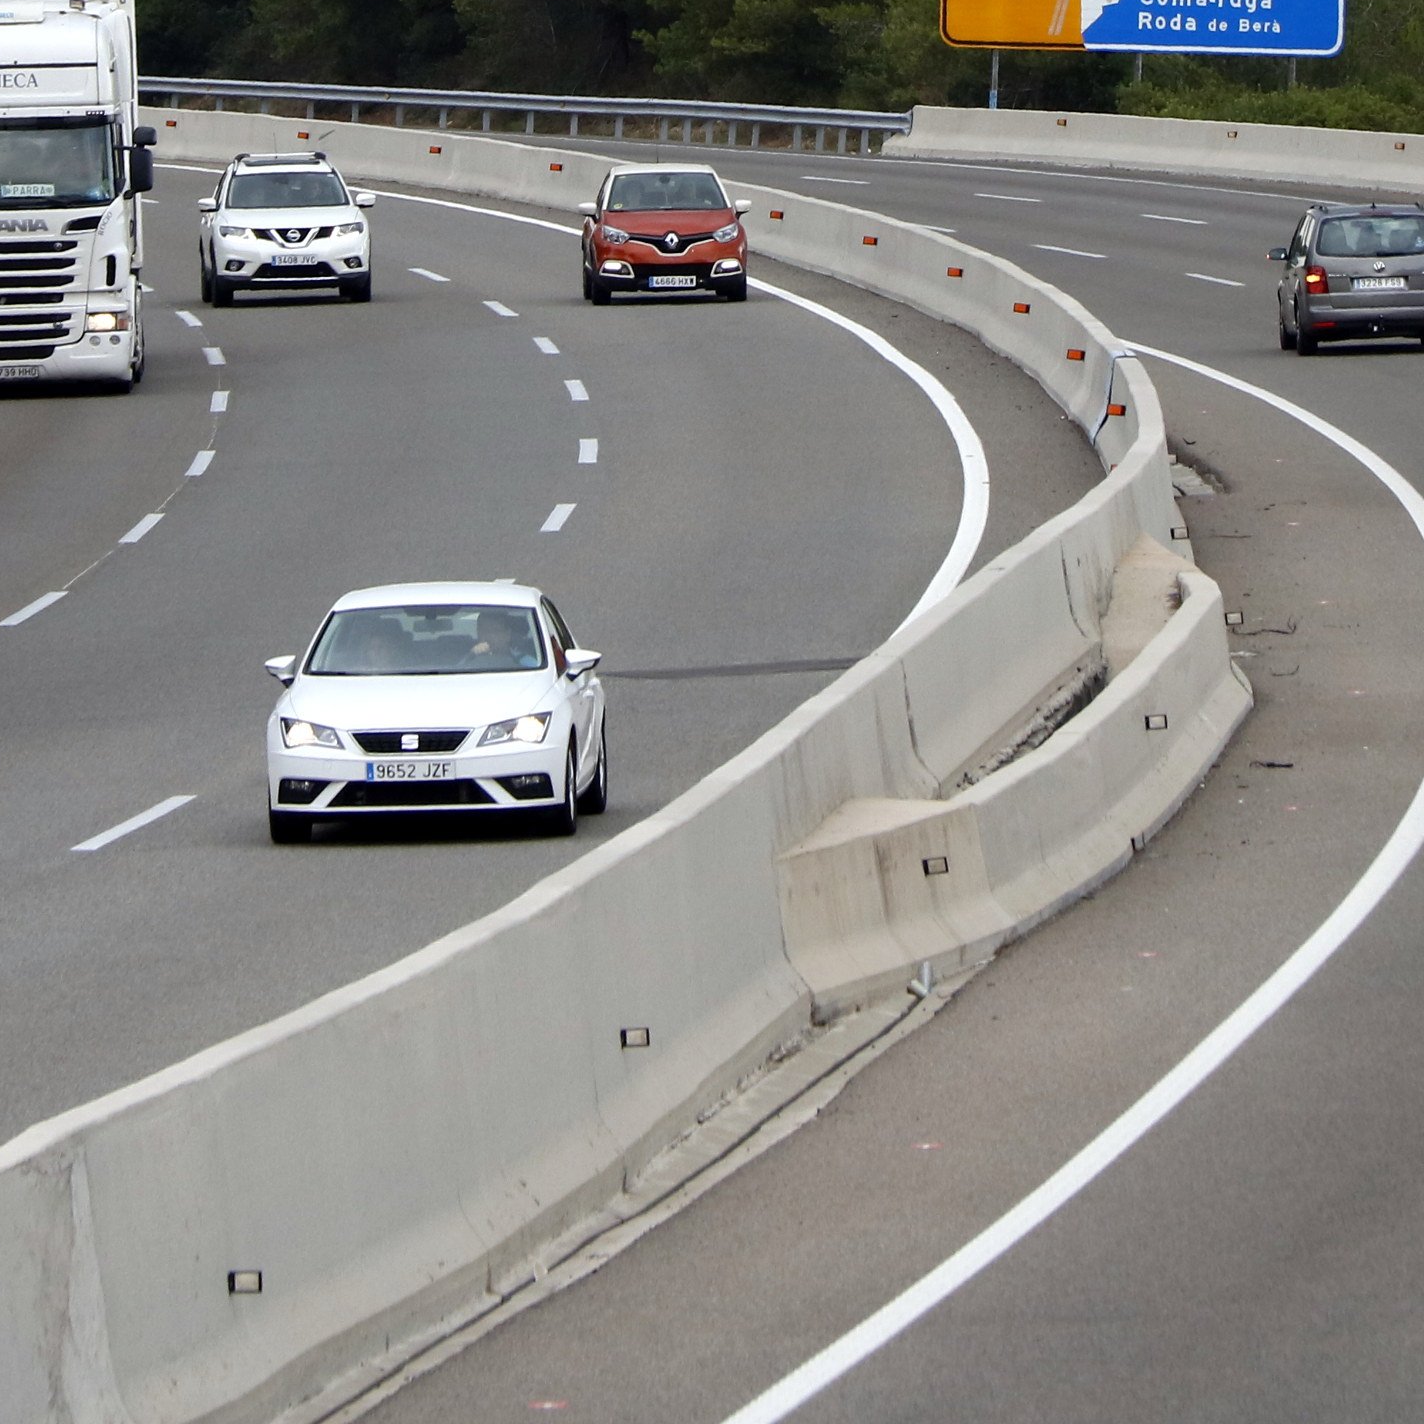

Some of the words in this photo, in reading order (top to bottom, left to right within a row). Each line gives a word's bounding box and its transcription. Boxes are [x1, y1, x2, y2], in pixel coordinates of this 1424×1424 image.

[1138, 12, 1197, 32] Roda
[1208, 17, 1229, 33] de
[1239, 18, 1281, 34] Berà
[376, 763, 416, 778] 9652
[423, 762, 451, 778] JZF
